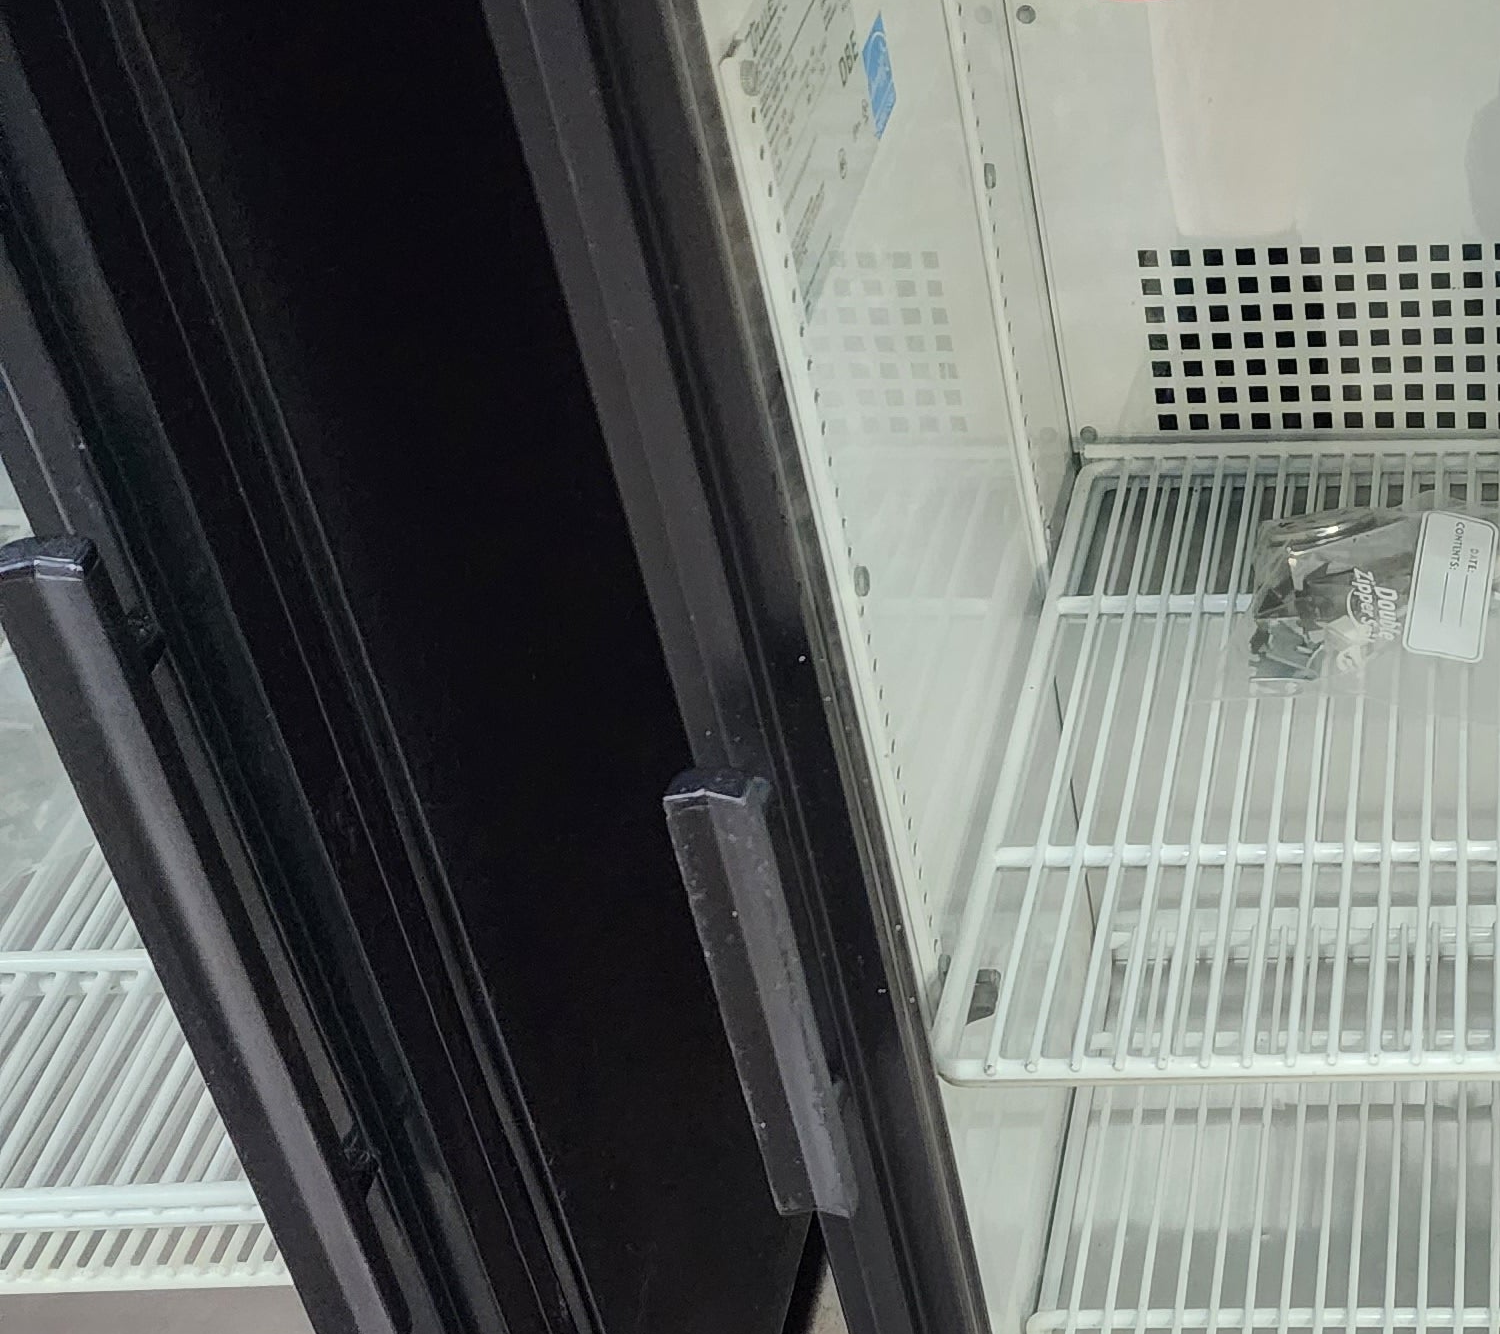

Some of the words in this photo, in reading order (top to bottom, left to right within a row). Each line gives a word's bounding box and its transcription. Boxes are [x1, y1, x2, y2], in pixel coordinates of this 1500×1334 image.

[1448, 521, 1466, 572] CONTENTS:
[1466, 547, 1480, 574] DATE:
[1352, 567, 1376, 617] Zipper
[1372, 585, 1400, 642] Double
